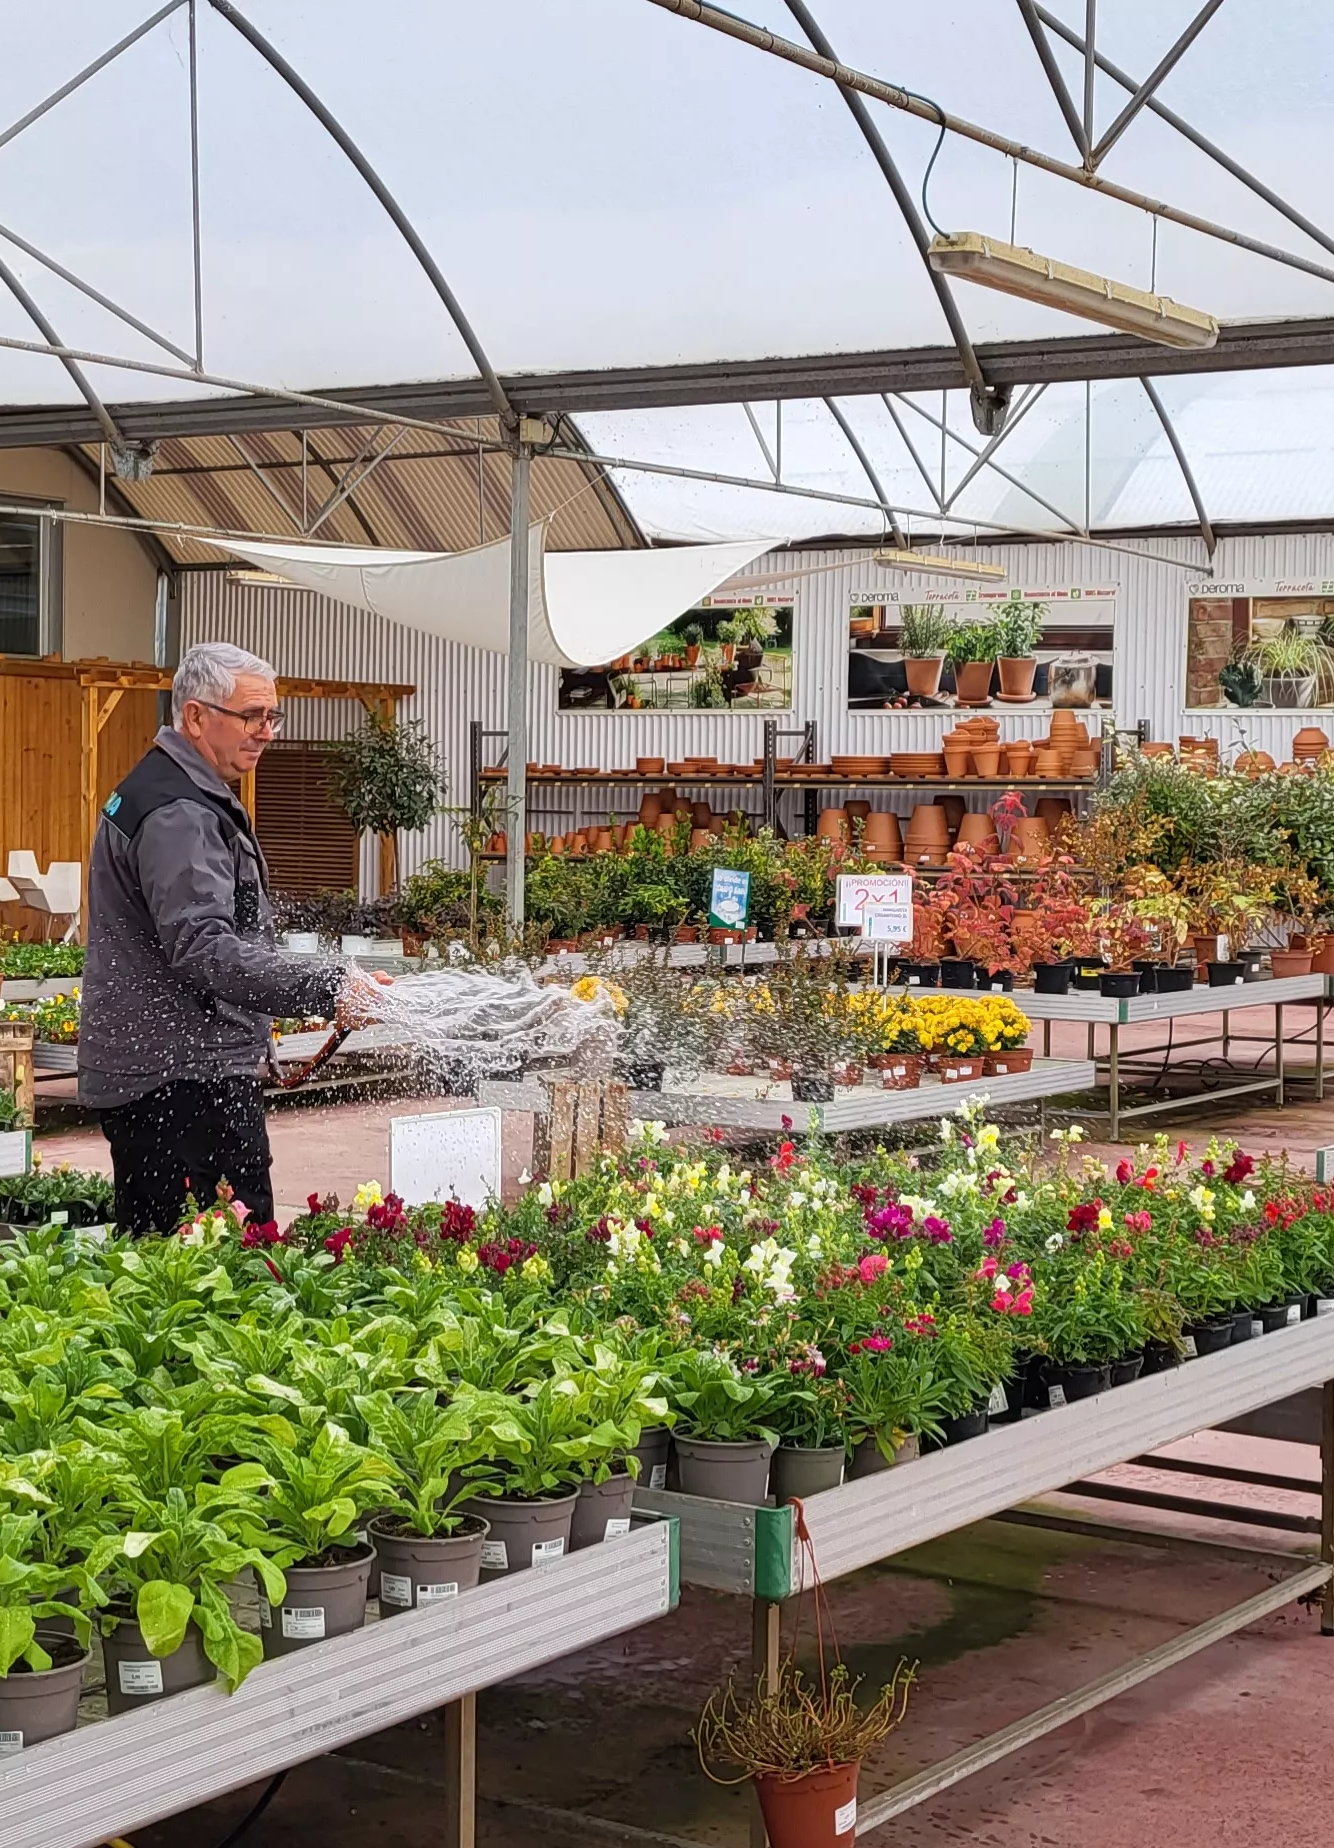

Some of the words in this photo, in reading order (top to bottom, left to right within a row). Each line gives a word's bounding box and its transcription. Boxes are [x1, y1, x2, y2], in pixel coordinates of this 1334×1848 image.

[1274, 580, 1315, 592] Terracota
[925, 589, 960, 600] Terracota
[887, 925, 902, 933] 5,95
